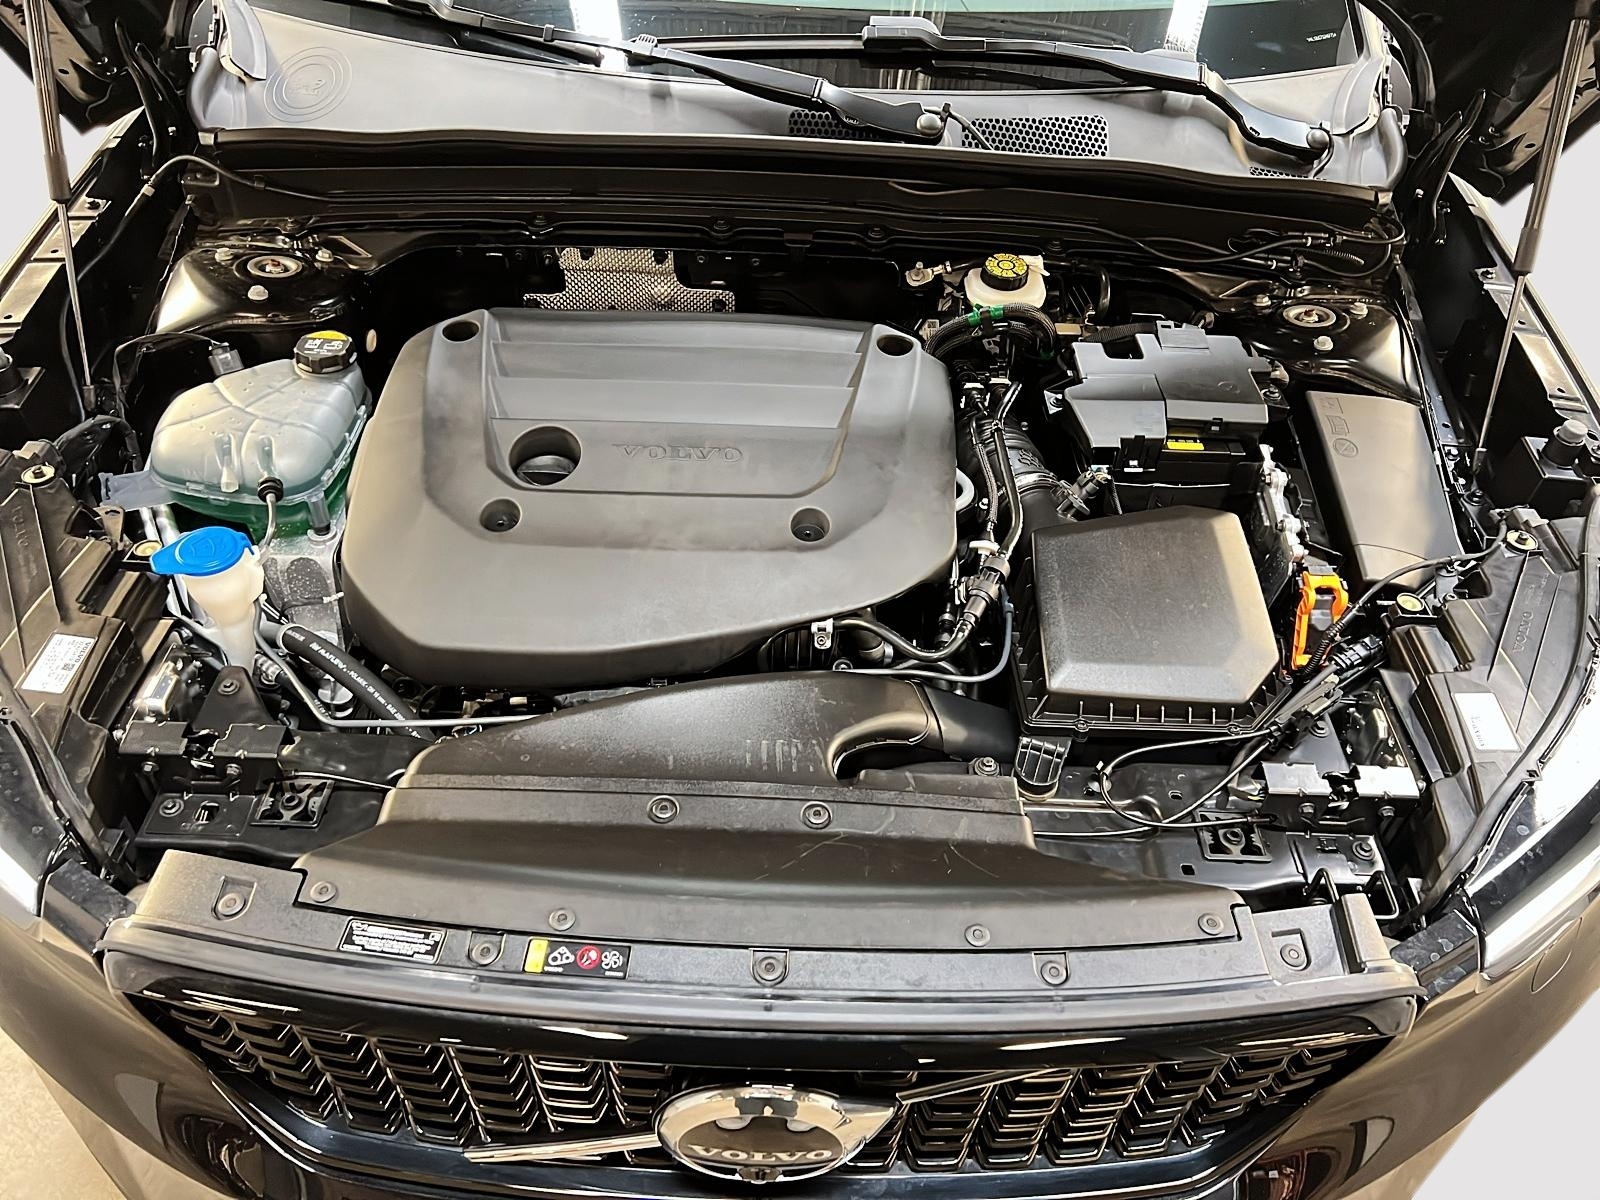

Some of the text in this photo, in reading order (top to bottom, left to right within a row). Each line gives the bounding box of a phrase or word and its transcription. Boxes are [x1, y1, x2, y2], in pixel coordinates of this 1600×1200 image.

[611, 444, 742, 461] VOLVO
[1513, 611, 1534, 654] VOLVO
[75, 641, 91, 663] VOLVO
[688, 1145, 832, 1161] VOLVO
